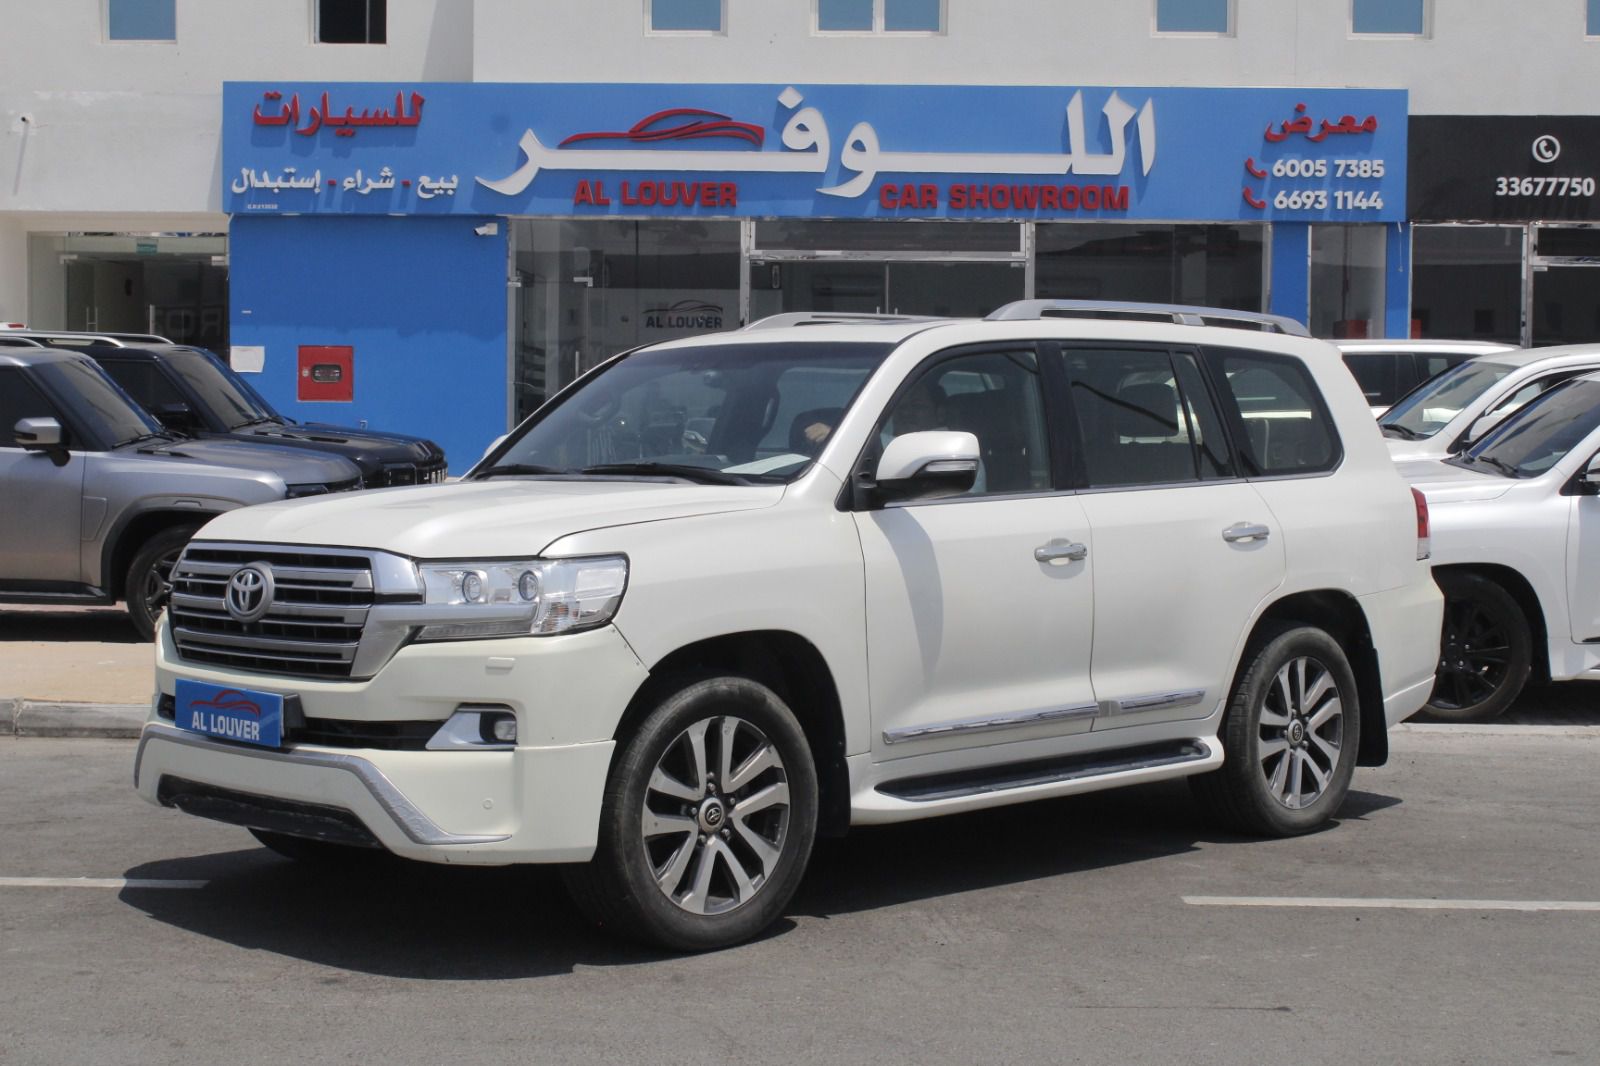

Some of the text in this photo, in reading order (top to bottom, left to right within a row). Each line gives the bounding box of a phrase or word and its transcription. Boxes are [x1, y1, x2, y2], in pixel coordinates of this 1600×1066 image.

[253, 90, 424, 136] للسيارات
[1264, 102, 1377, 142] معرض
[1272, 159, 1385, 178] 6005 7385
[231, 166, 459, 199] بيع شراء إستبدال
[574, 180, 737, 208] AL LOUVER
[1495, 177, 1596, 197] 33677750
[879, 183, 1129, 210] CAR SHOWROOM
[1273, 190, 1384, 210] 6693 1144
[645, 315, 722, 329] AL LOUVER
[191, 711, 260, 741] AL LOUVER
